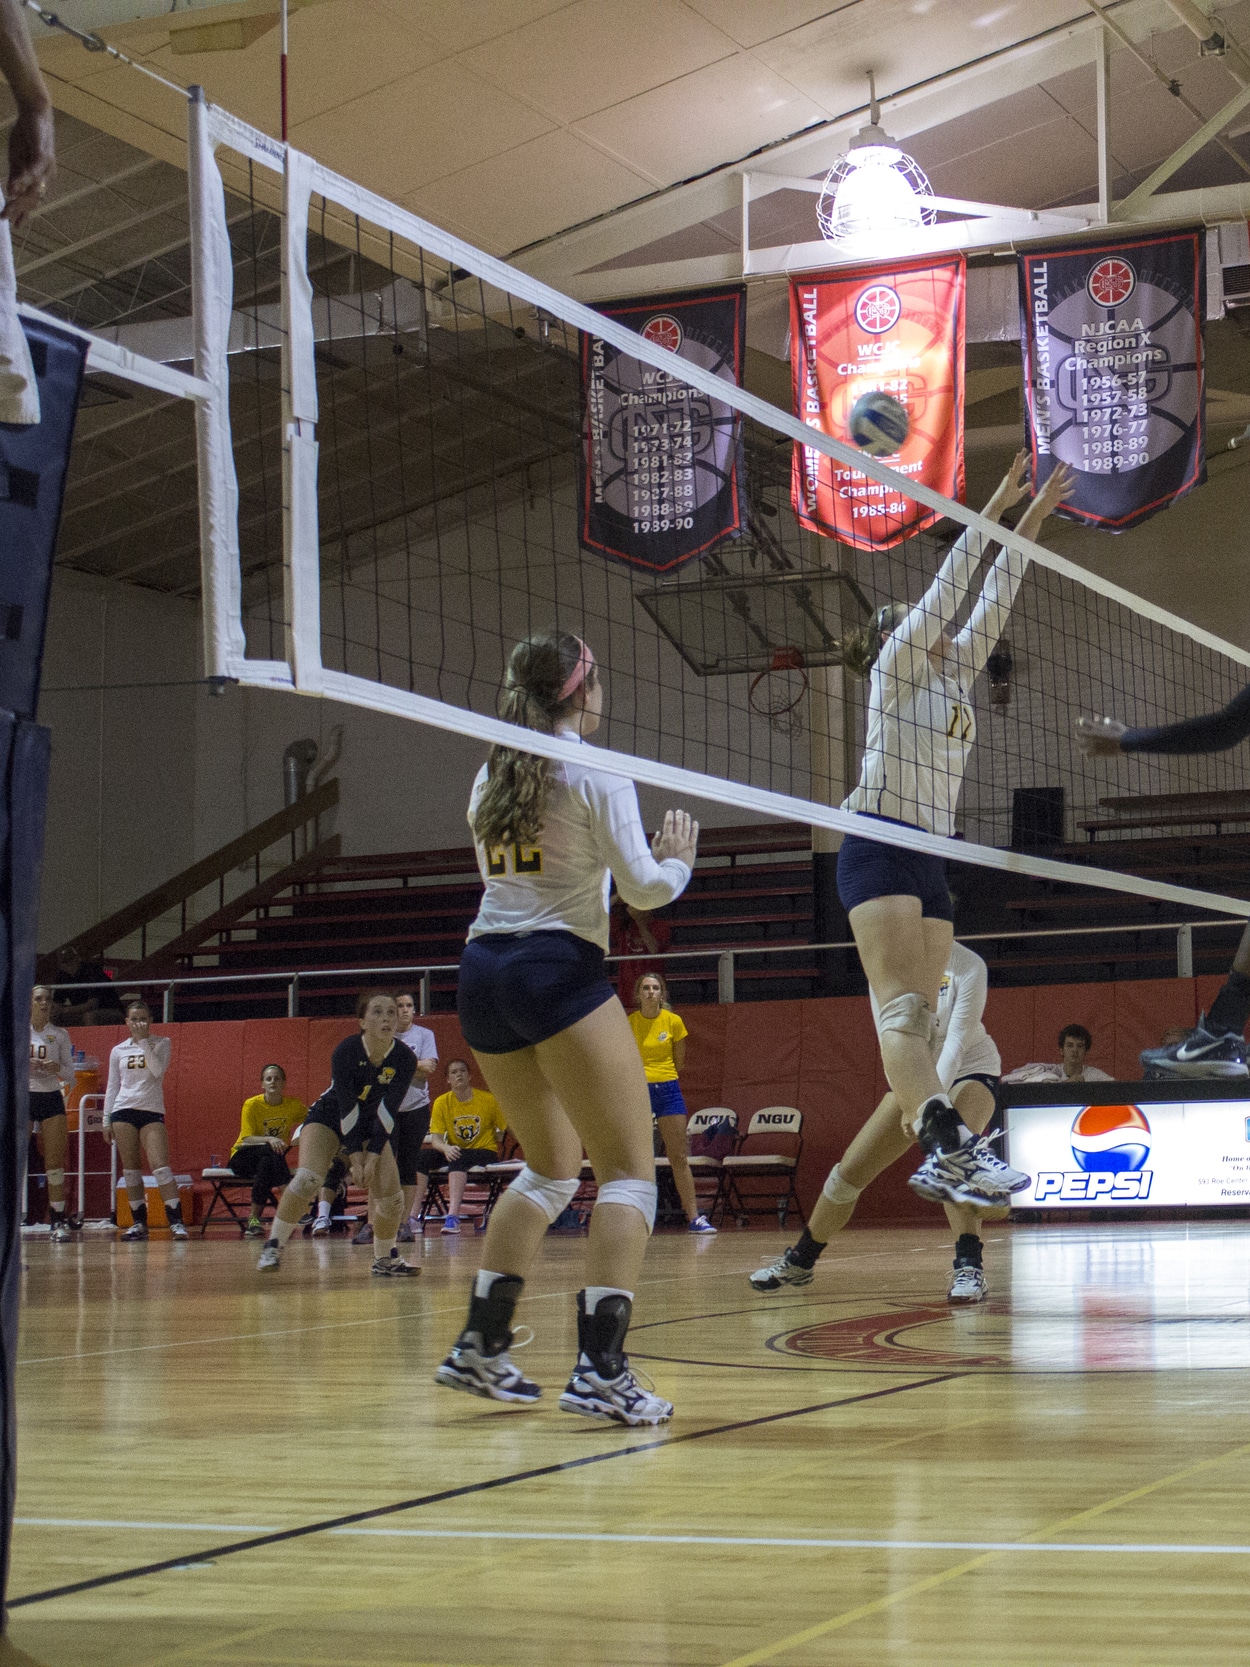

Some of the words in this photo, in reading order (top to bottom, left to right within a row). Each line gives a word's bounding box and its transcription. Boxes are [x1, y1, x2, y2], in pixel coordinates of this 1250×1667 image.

[1033, 262, 1050, 391] BASKETBALL
[1081, 318, 1145, 337] NJCAA
[803, 288, 820, 414] BASKETBALL
[1074, 337, 1136, 355] Region
[1140, 331, 1151, 345] X
[1064, 349, 1162, 371] Champions
[590, 335, 605, 441] BASKETBA
[1081, 370, 1147, 390] 1956-57
[620, 387, 705, 406] Champions
[1082, 387, 1148, 406] 1957-58
[1082, 403, 1148, 423] 1972-73
[633, 419, 693, 437] 1971-72
[1036, 397, 1050, 455] MEN'S
[1082, 419, 1148, 439] 1976-77
[633, 435, 693, 453] 1973-74
[1082, 435, 1149, 455] 1988-89
[803, 417, 821, 512] WOMES
[1083, 452, 1149, 471] 1989-90
[633, 468, 693, 486] 1982-83
[839, 482, 899, 499] Champi
[852, 501, 907, 519] 1985-86
[633, 516, 693, 534] 1989-90
[127, 1054, 147, 1070] 23
[757, 1114, 796, 1124] NGU
[1034, 1170, 1154, 1201] PEPSI
